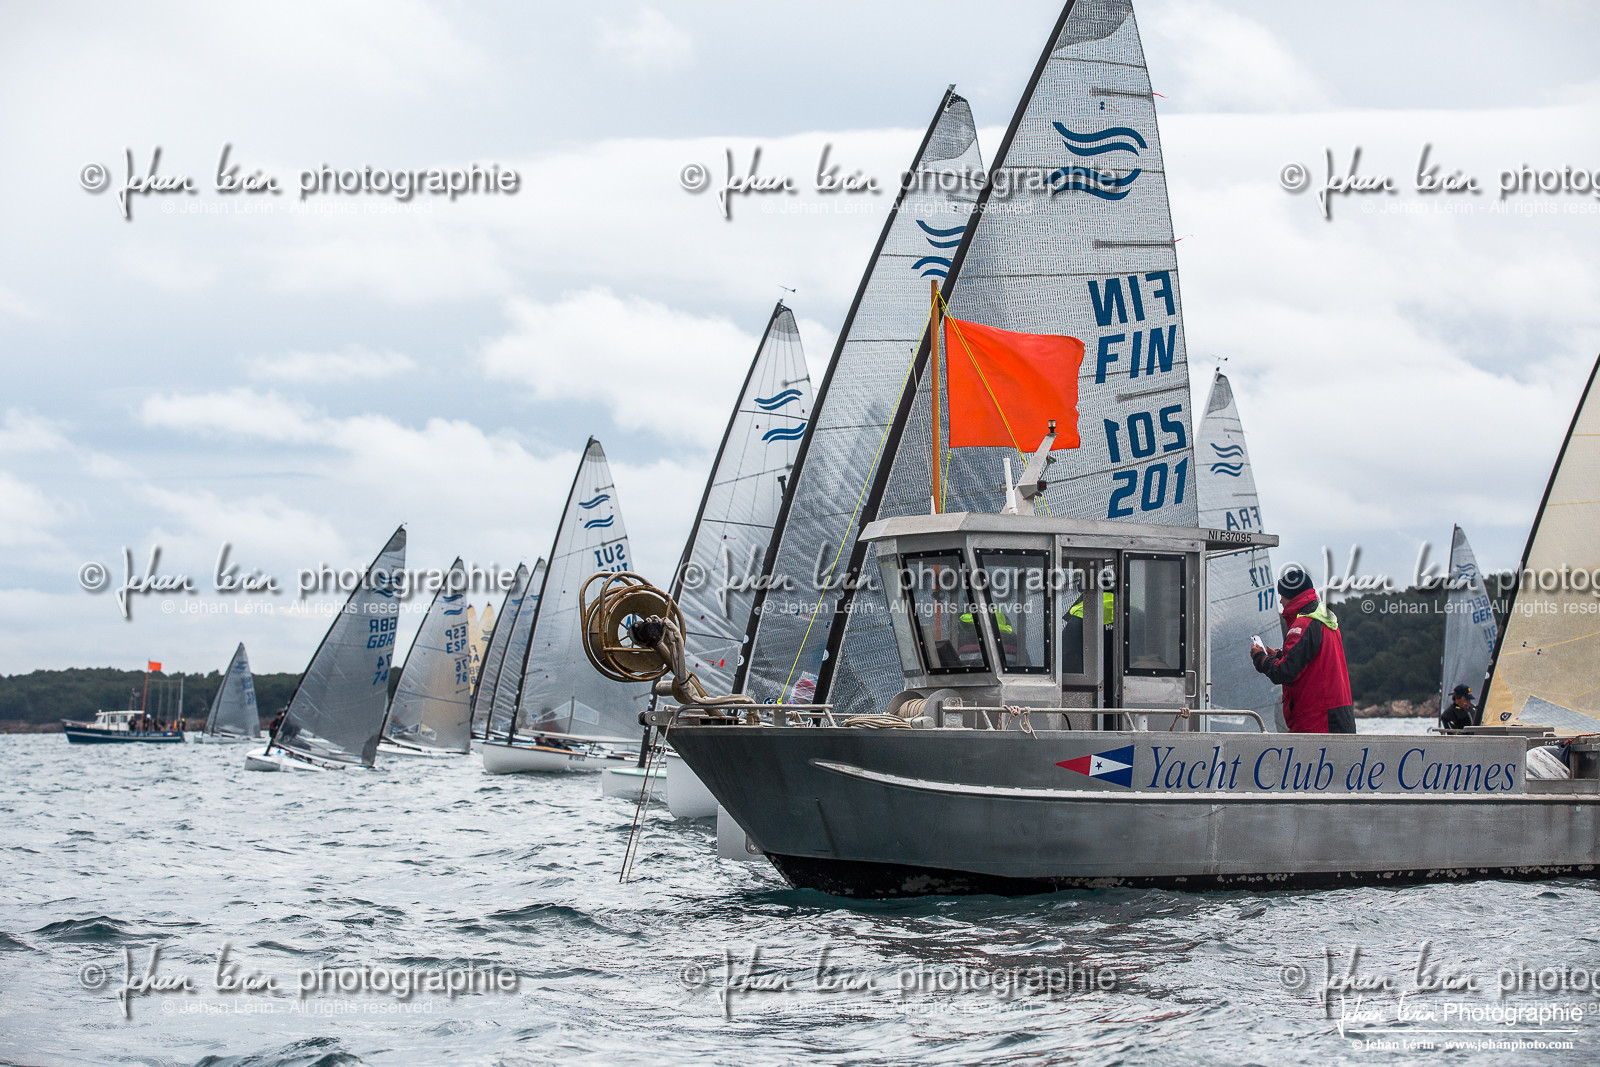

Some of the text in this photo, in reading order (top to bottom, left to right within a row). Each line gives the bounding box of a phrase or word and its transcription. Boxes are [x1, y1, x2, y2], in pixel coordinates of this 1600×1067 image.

[1095, 325, 1176, 384] FIN
[1107, 457, 1188, 518] 201
[1220, 531, 1252, 543] F37095
[1257, 587, 1275, 612] 117
[366, 632, 396, 649] GBR
[446, 639, 467, 654] ESP
[372, 669, 389, 686] 74
[1146, 745, 1517, 791] Yacht Club de Cannes
